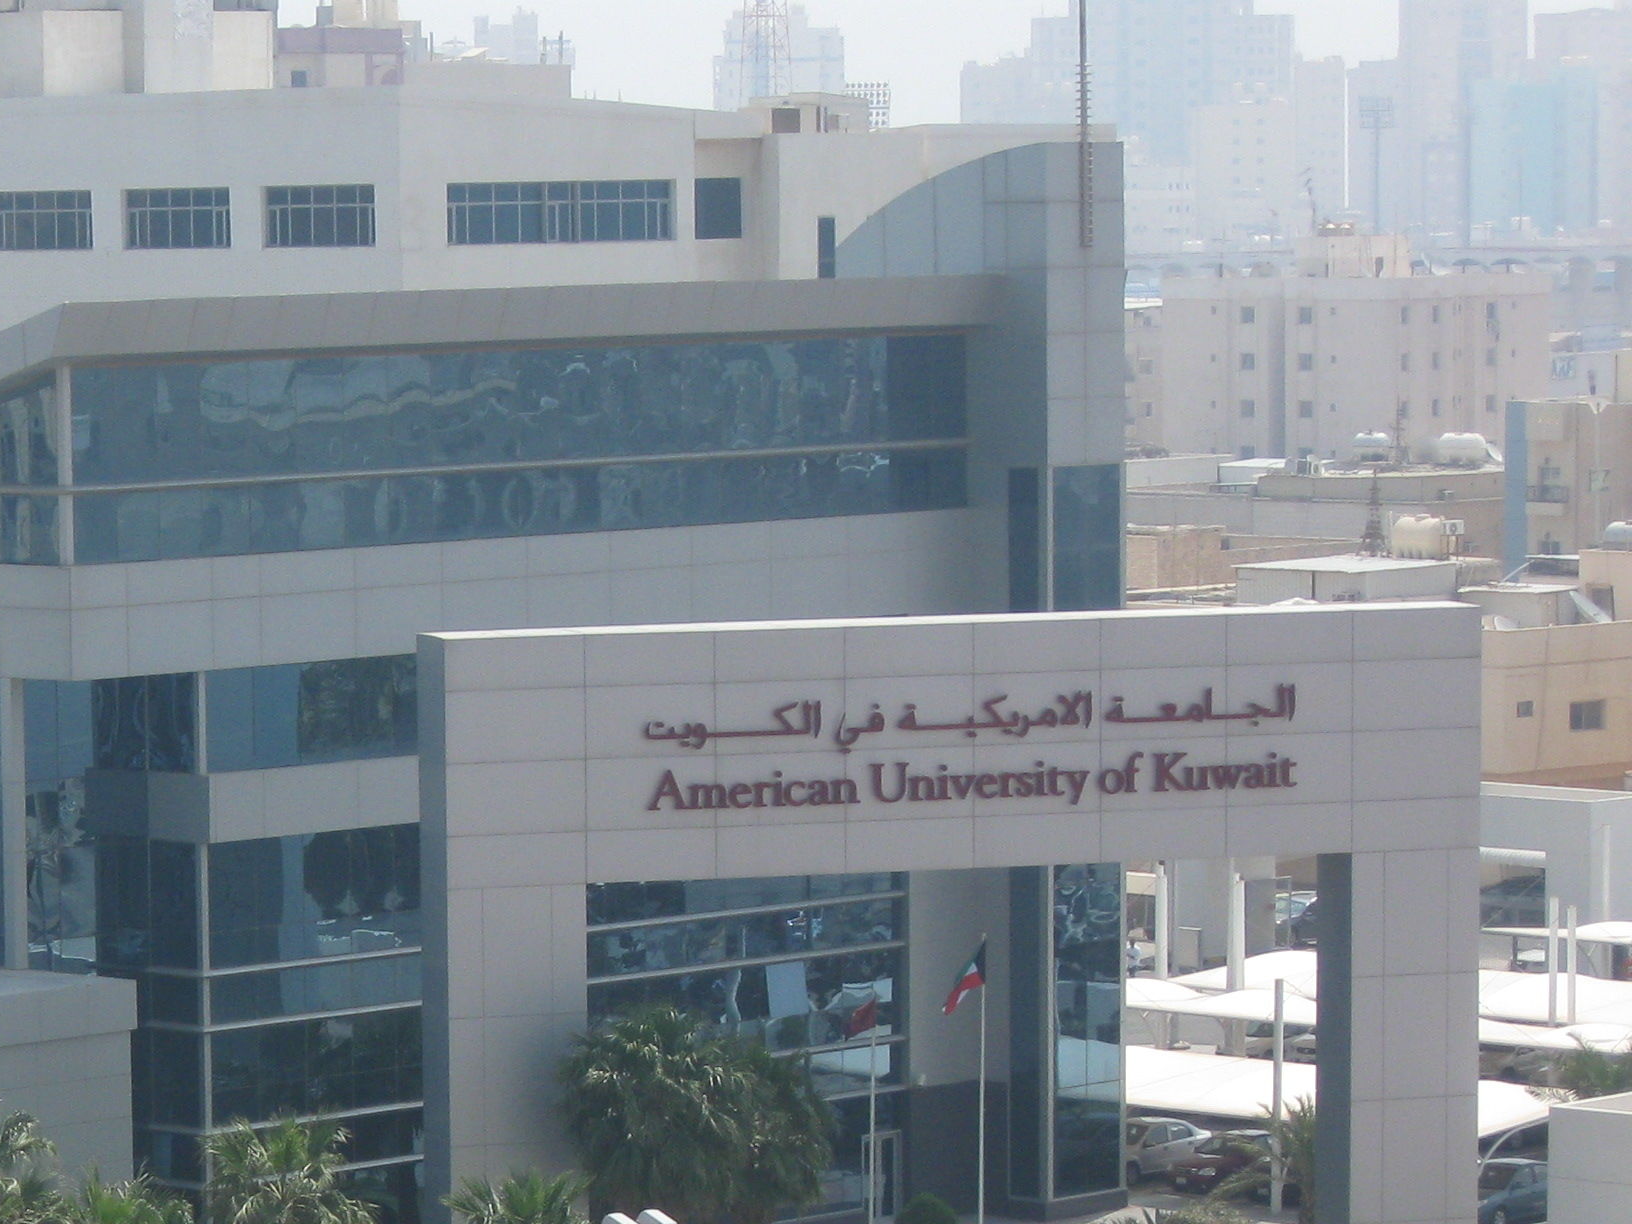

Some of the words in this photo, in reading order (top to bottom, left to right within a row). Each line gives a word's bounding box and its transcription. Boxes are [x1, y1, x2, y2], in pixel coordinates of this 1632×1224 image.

[644, 700, 822, 750] الكويت
[834, 702, 885, 754] في
[1104, 682, 1297, 728] الجامعة
[647, 770, 861, 812] American
[867, 757, 1090, 807] University
[1099, 753, 1144, 796] of
[1151, 751, 1299, 793] Kuwait
